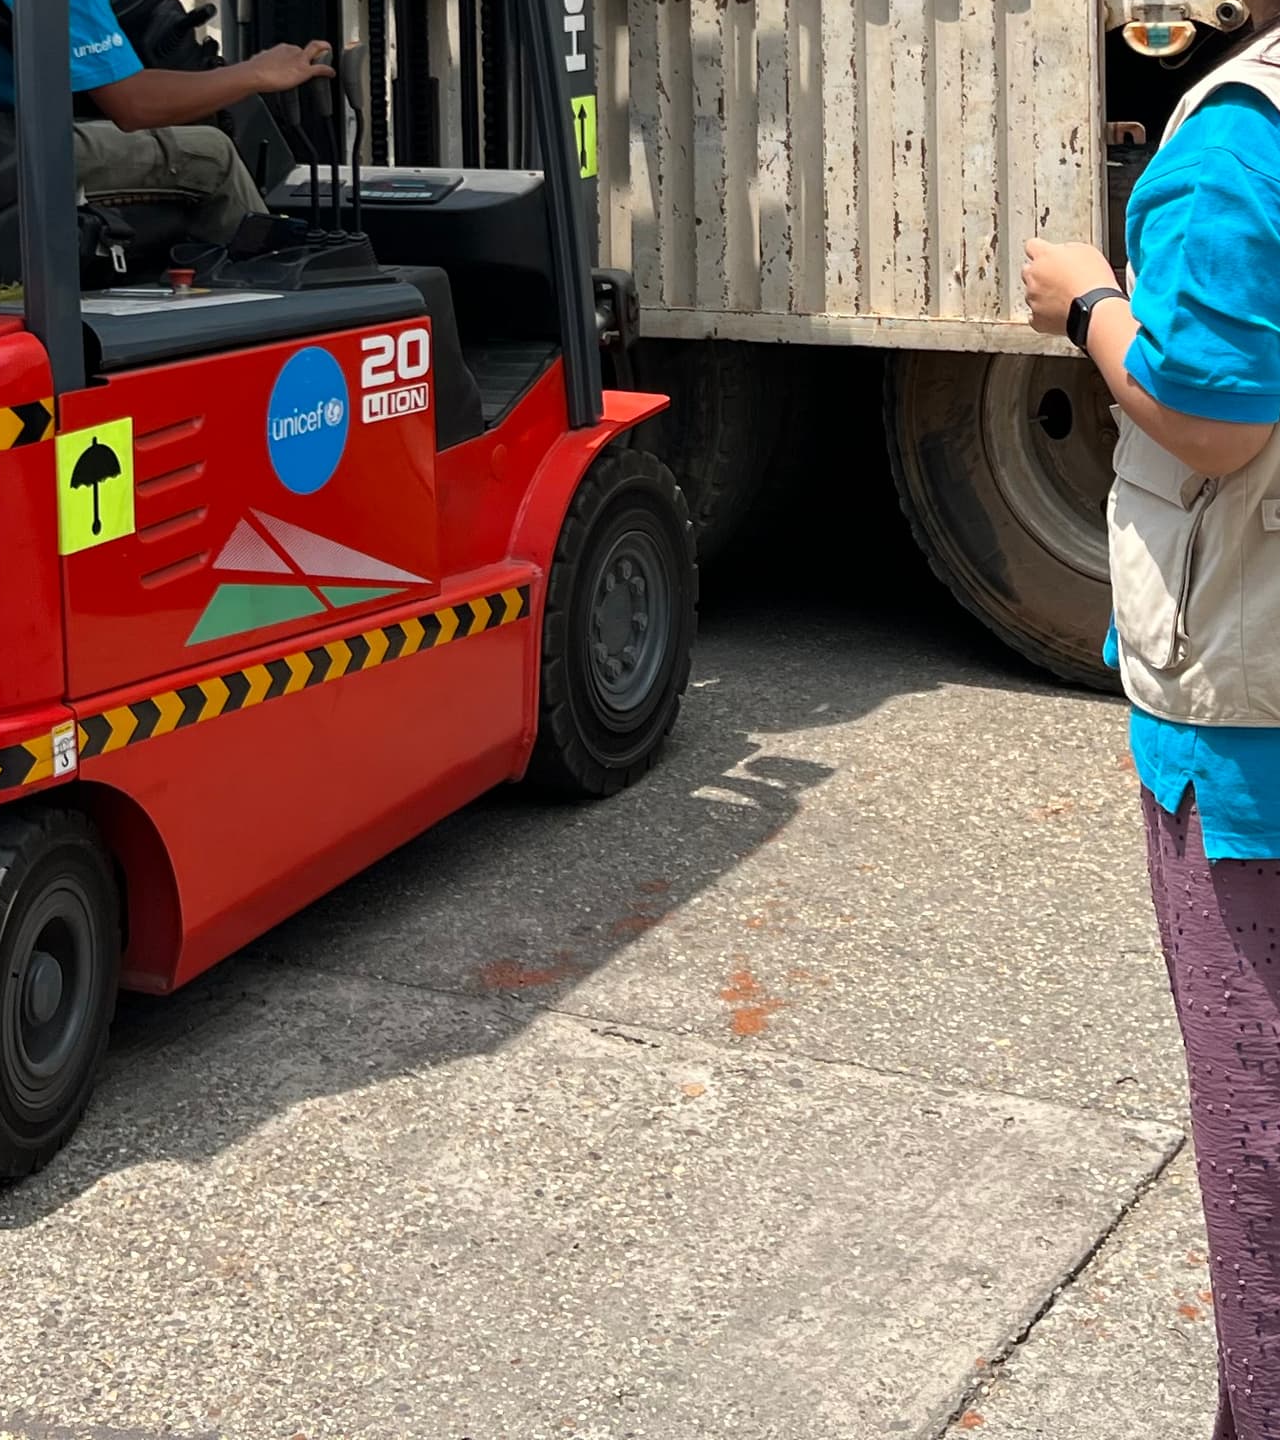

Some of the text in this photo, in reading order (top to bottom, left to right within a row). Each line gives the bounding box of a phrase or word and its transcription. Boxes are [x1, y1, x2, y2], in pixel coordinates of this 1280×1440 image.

[73, 34, 112, 58] unicef
[361, 328, 430, 389] 20
[389, 387, 426, 415] ION
[272, 401, 324, 441] unicef
